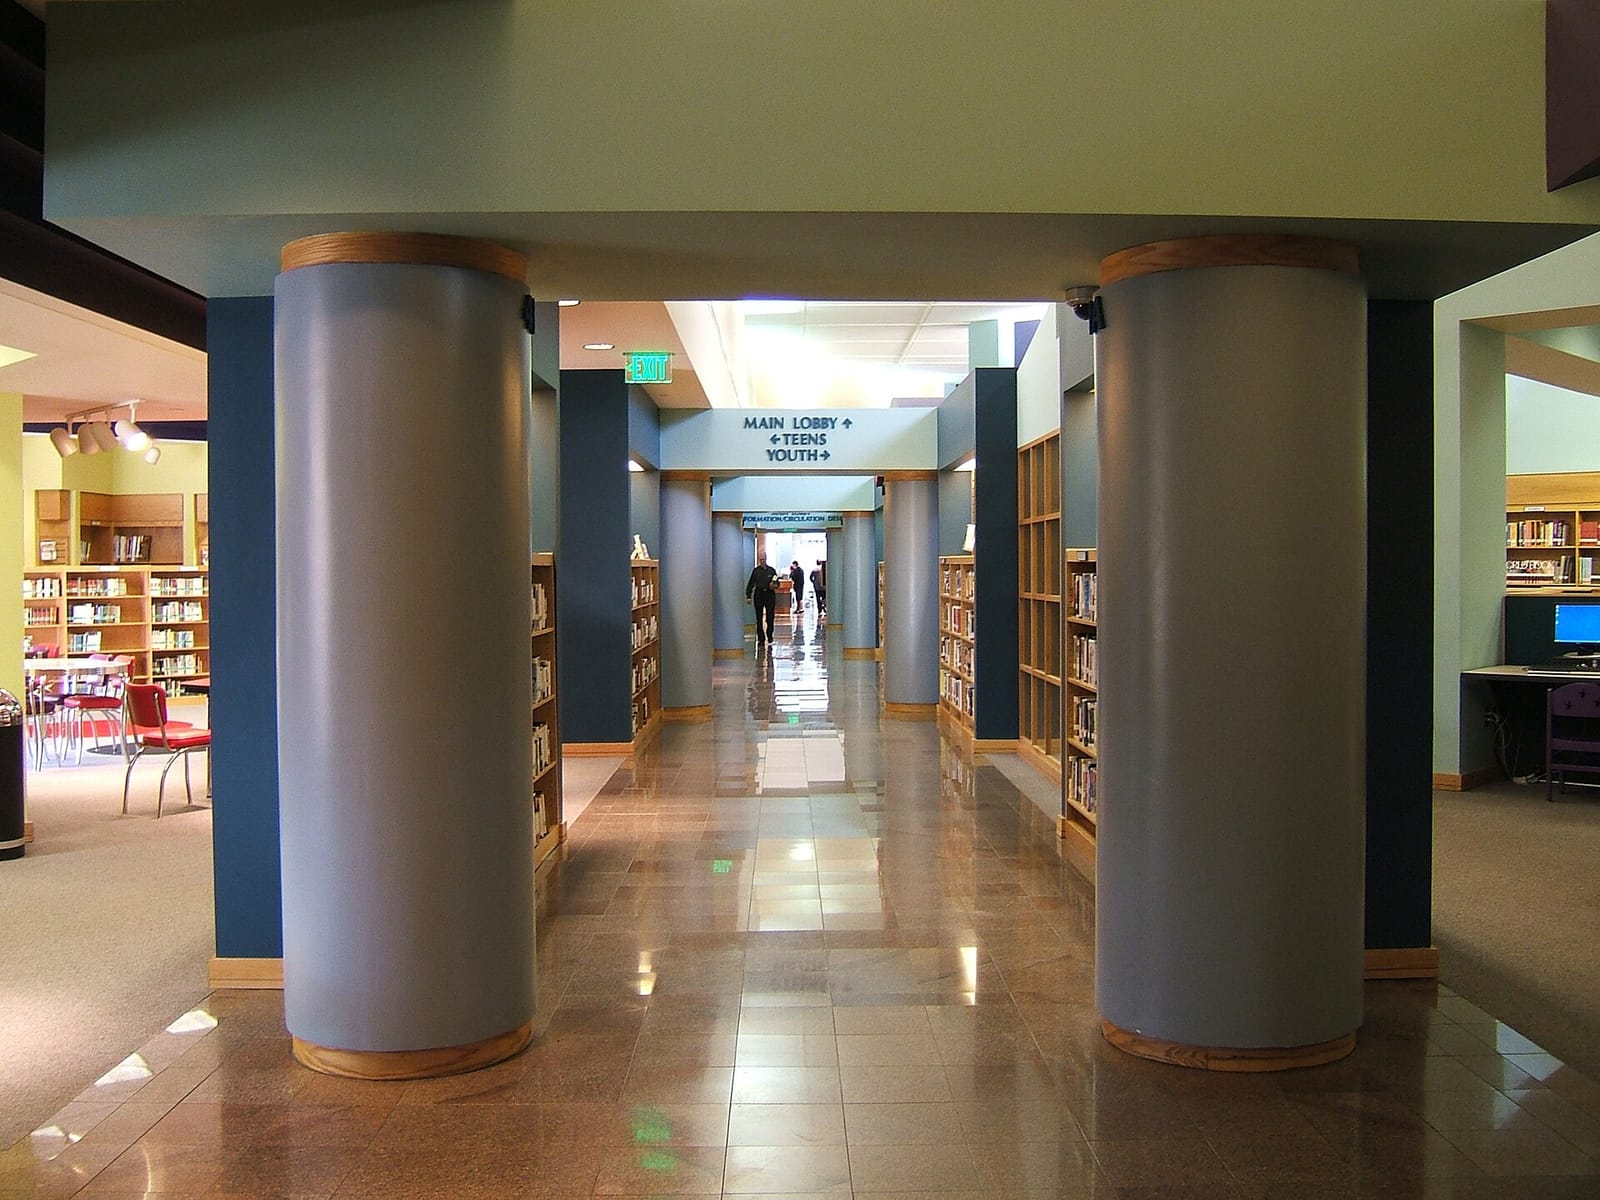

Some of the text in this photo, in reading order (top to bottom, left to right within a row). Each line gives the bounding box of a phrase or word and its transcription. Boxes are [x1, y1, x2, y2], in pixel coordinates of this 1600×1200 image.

[632, 355, 668, 380] EXIT
[744, 417, 838, 430] MAIN LOBBY
[782, 433, 827, 446] TEENS
[766, 449, 818, 461] YOUTH
